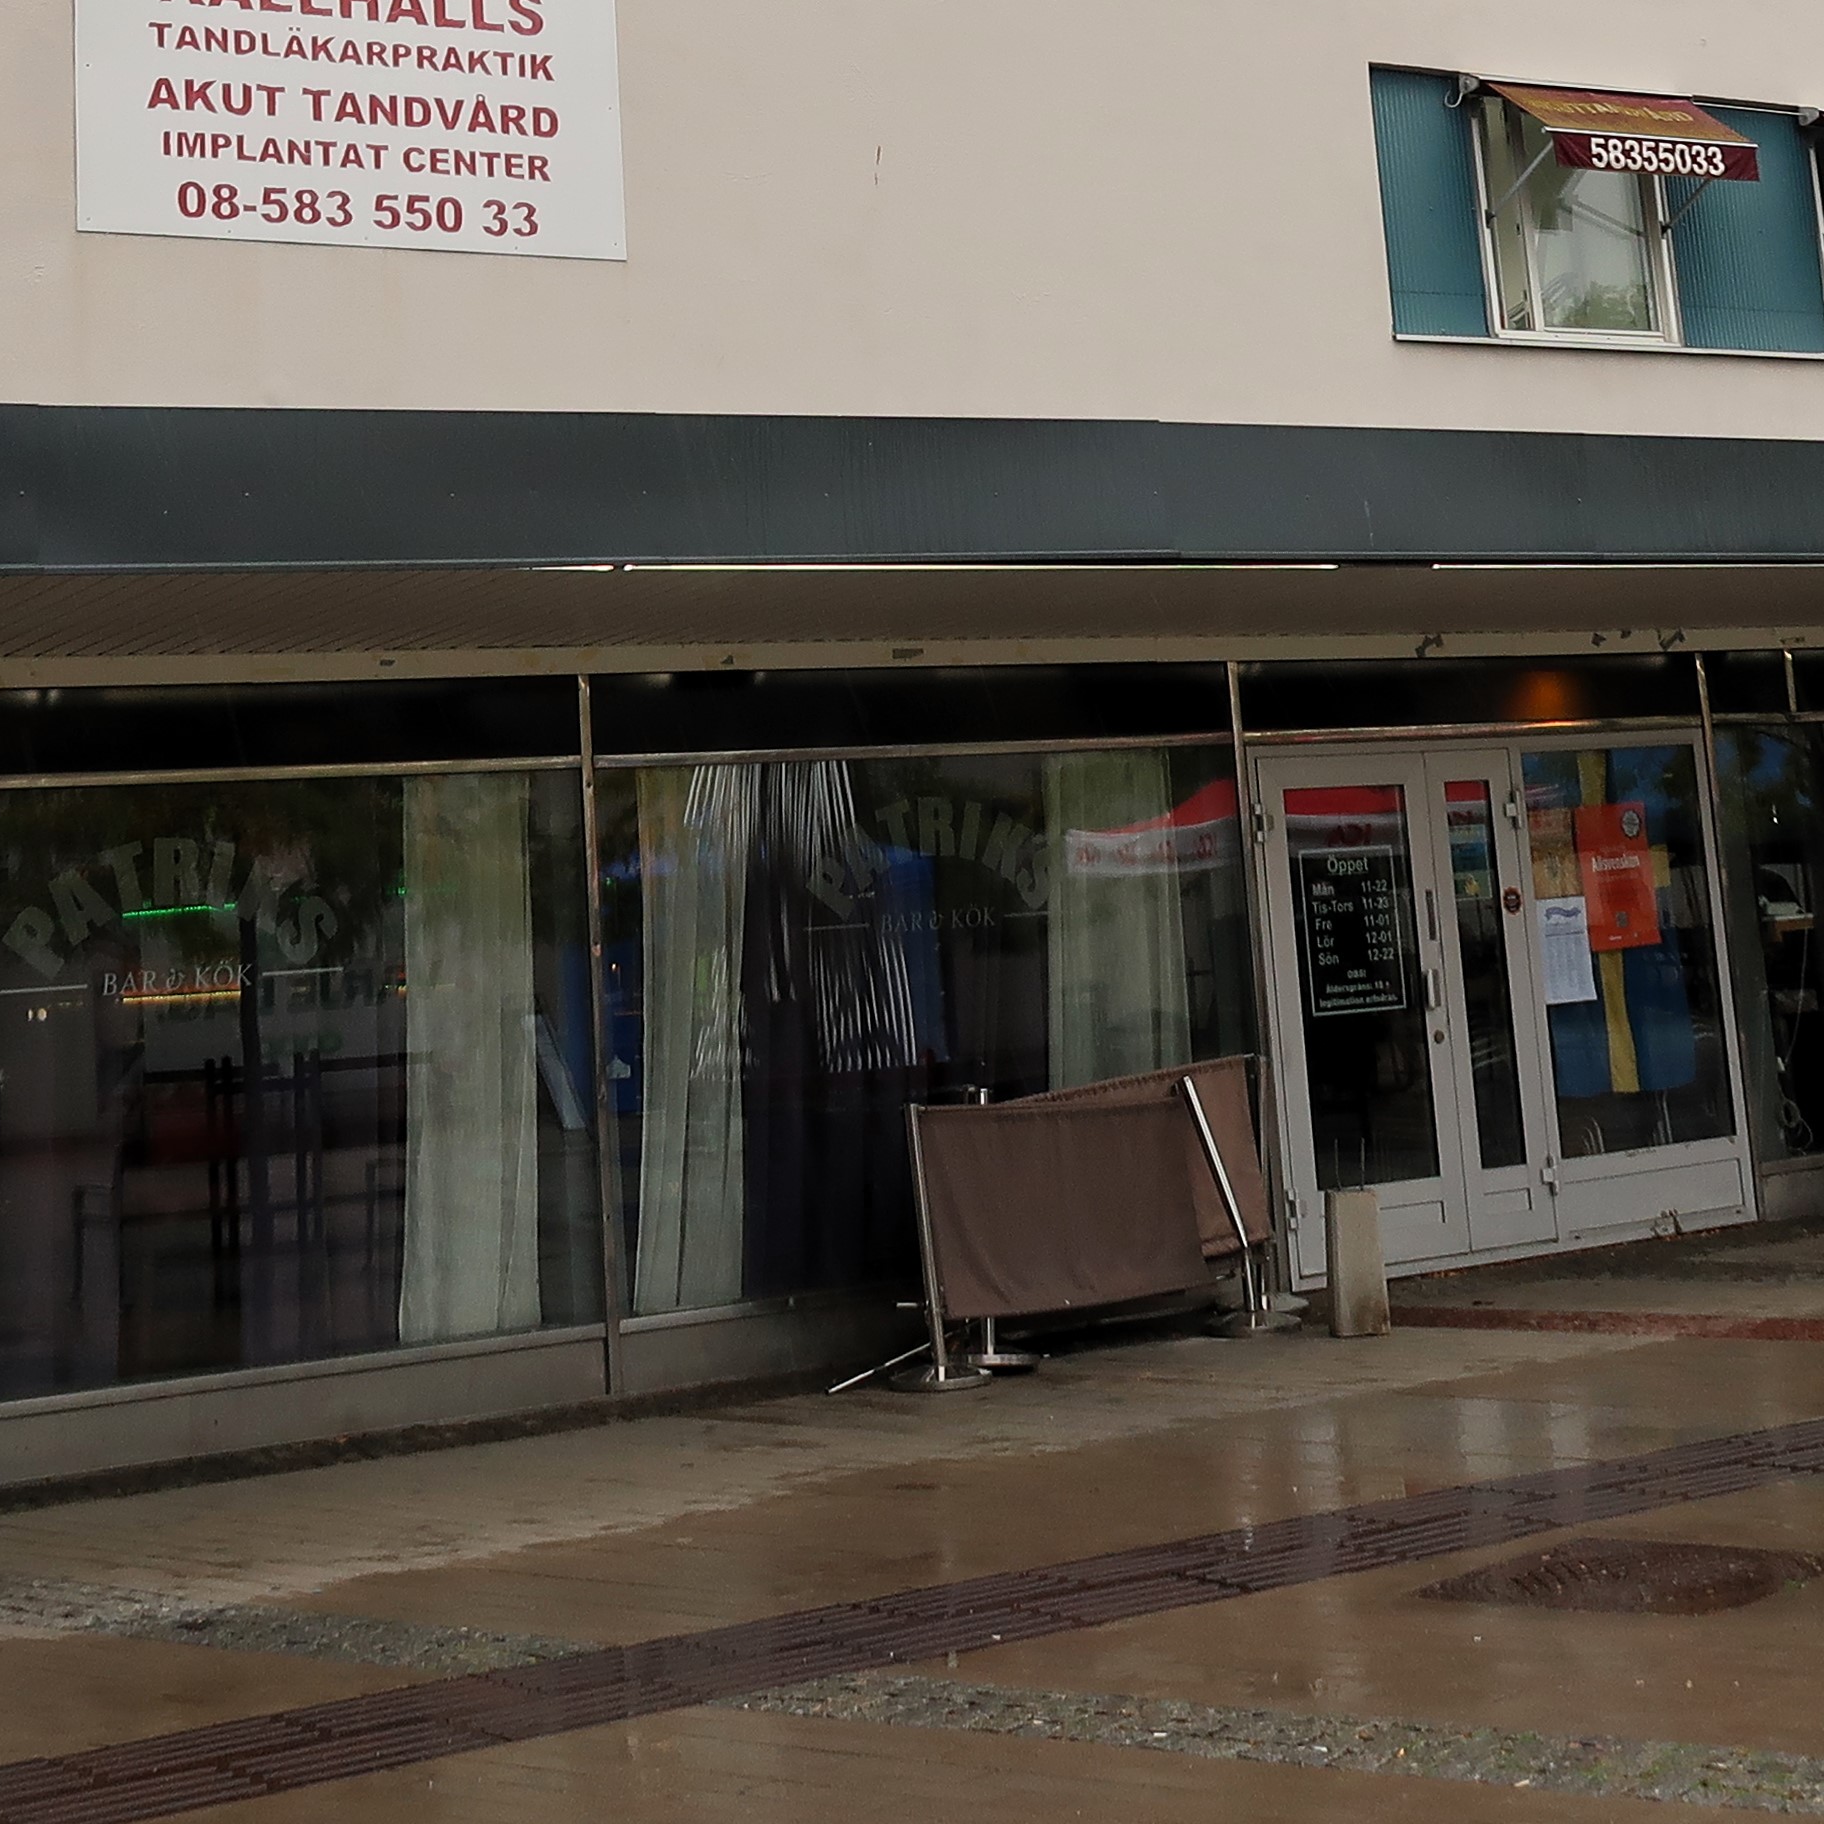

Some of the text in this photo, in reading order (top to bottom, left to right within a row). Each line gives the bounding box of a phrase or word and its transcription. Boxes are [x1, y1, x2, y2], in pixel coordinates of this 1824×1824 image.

[149, 22, 556, 81] TANDLÄKARPRAKTIK
[147, 77, 560, 139] AKUT TANDVÅRD
[162, 131, 551, 181] IMPLANTAT CENTER
[1591, 136, 1725, 176] 58355033
[177, 180, 539, 237] 08-583 550 33
[1327, 854, 1370, 876] Öppet
[1312, 879, 1388, 896] Mån 11-22
[951, 902, 997, 928] KÖK
[1312, 896, 1389, 914] Tis-Tors 11-23
[1315, 913, 1390, 931] Fre 11-01
[1317, 930, 1392, 948] Lör 12-01
[1318, 947, 1394, 966] Sön 12-22
[102, 968, 155, 997] BAR
[194, 959, 254, 990] KÖK
